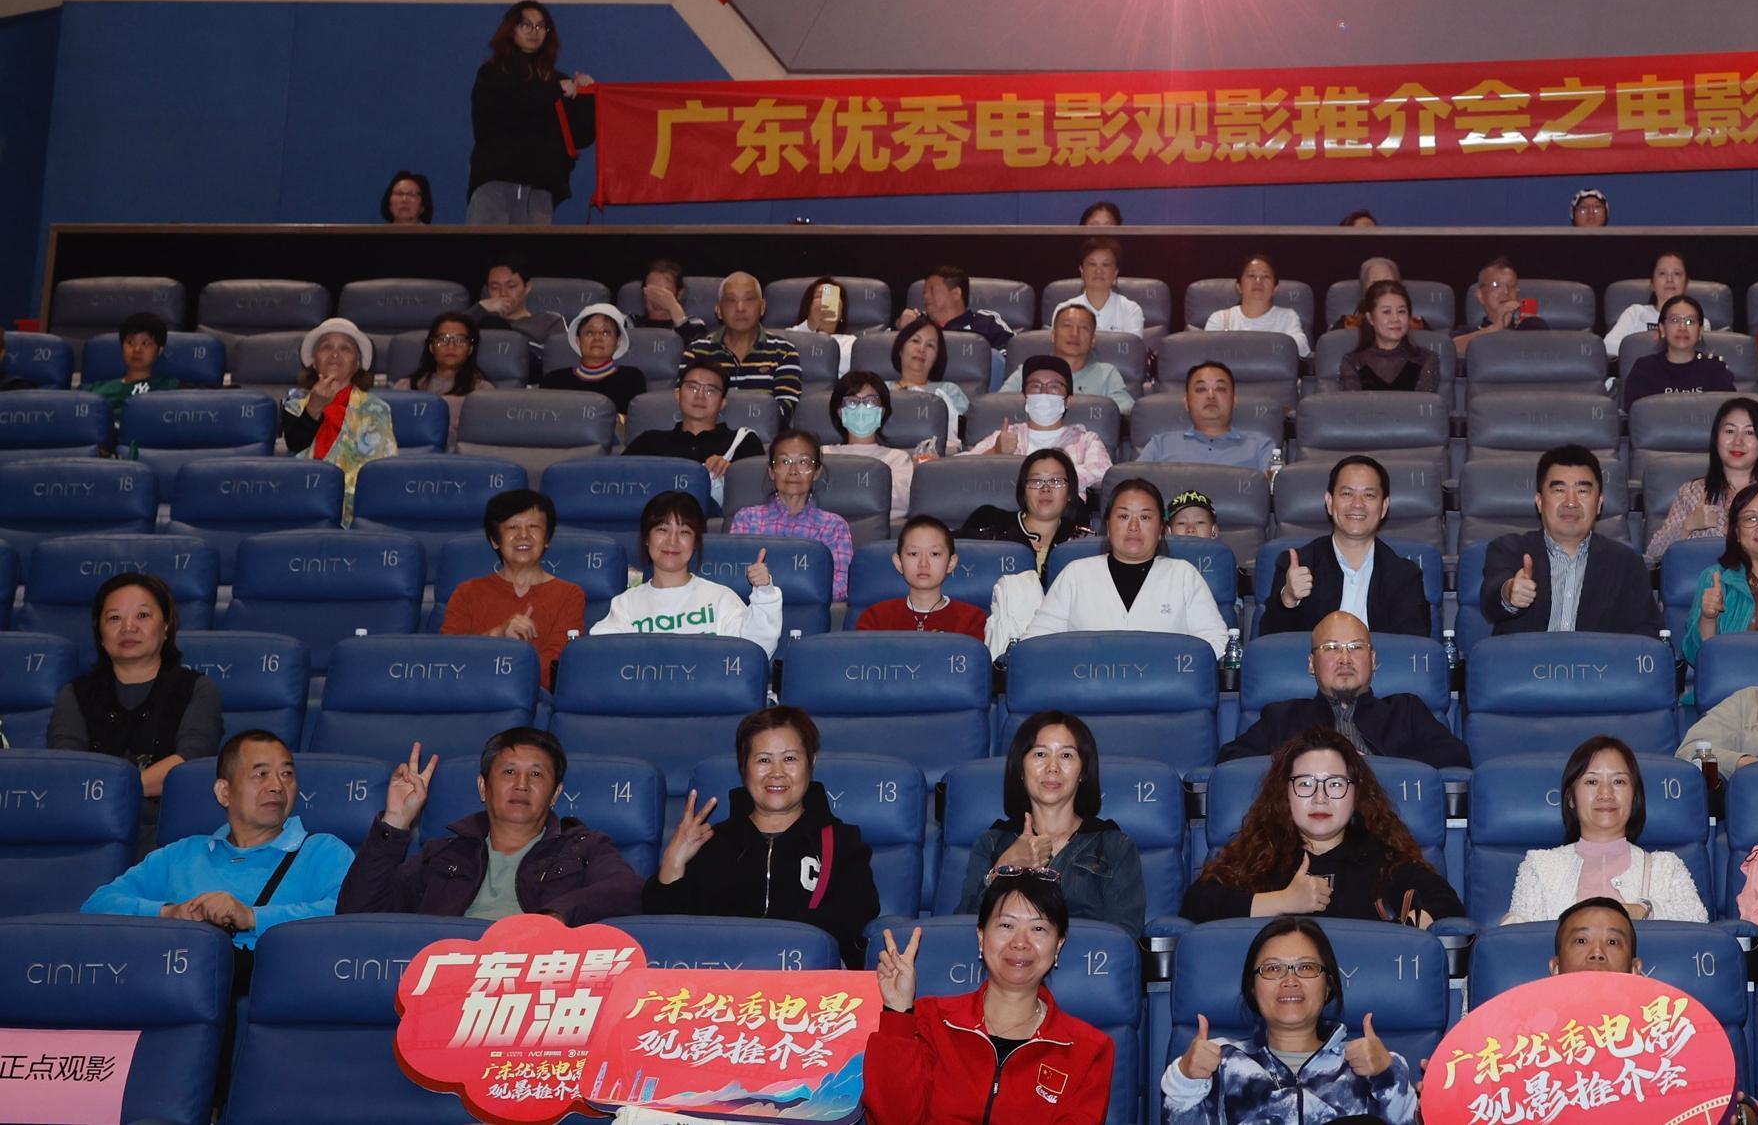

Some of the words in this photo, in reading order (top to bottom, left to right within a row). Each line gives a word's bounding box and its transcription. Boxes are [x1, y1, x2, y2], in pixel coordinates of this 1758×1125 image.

[236, 294, 281, 308] CINITY
[377, 295, 423, 308] CINITY
[440, 292, 453, 305] 18
[865, 289, 876, 301] 15
[1009, 290, 1020, 302] 14
[1146, 289, 1157, 300] 13
[1289, 290, 1300, 301] 12
[32, 347, 52, 361] 20
[193, 347, 206, 360] 19
[497, 341, 511, 354] 17
[653, 340, 666, 354] 16
[811, 344, 823, 356] 15
[962, 344, 973, 356] 14
[1117, 343, 1129, 355] 13
[1272, 343, 1284, 355] 12
[1430, 343, 1441, 355] 11
[1580, 344, 1592, 356] 10
[1736, 344, 1743, 356] 9
[74, 405, 88, 418] 19
[163, 410, 219, 424] CINITY
[240, 405, 255, 418] 18
[413, 403, 427, 417] 17
[506, 408, 561, 422] CINITY
[582, 405, 597, 419] 16
[748, 405, 761, 419] 15
[916, 405, 929, 419] 14
[1089, 406, 1102, 419] 13
[1255, 405, 1269, 418] 12
[1418, 404, 1433, 418] 11
[1591, 406, 1604, 420] 10
[119, 477, 134, 492] 18
[220, 480, 280, 494] CINITY
[306, 475, 320, 490] 17
[405, 480, 466, 494] CINITY
[488, 473, 503, 488] 16
[673, 475, 688, 490] 15
[856, 472, 870, 487] 14
[1237, 480, 1251, 494] 12
[1410, 472, 1425, 487] 11
[33, 481, 95, 496] CINITY
[590, 481, 651, 495] CINITY
[174, 554, 191, 570] 17
[289, 557, 357, 573] CINITY
[381, 549, 399, 566] 16
[586, 553, 602, 569] 15
[791, 554, 808, 570] 14
[999, 556, 1015, 573] 13
[1198, 555, 1214, 572] 12
[80, 560, 148, 575] CINITY
[631, 602, 716, 634] mardi
[25, 653, 45, 671] 17
[260, 654, 279, 672] 16
[494, 656, 512, 674] 15
[722, 656, 742, 675] 14
[948, 655, 967, 673] 13
[1174, 654, 1194, 673] 12
[1410, 654, 1430, 673] 11
[1635, 654, 1655, 673] 10
[389, 662, 467, 680] CINITY
[621, 664, 697, 681] CINITY
[845, 663, 921, 681] CINITY
[1074, 662, 1149, 680] CINITY
[1533, 664, 1609, 680] CINITY
[81, 780, 103, 801] 16
[346, 780, 367, 801] 15
[611, 781, 632, 802] 14
[876, 781, 897, 803] 13
[1134, 781, 1156, 803] 12
[1400, 780, 1422, 801] 11
[1661, 778, 1682, 800] 10
[163, 949, 189, 975] 15
[777, 950, 803, 971] 13
[1082, 950, 1110, 975] 12
[1394, 954, 1420, 980] 11
[1691, 952, 1716, 977] 10
[27, 962, 128, 985] CINITY
[411, 947, 637, 996] 广东电影
[448, 989, 604, 1049] 加油
[625, 987, 865, 1042] 广东优秀电影
[632, 1025, 836, 1072] 观影推介会
[1442, 995, 1698, 1091] 广东优秀电影
[0, 1054, 116, 1082] 正点观影
[1466, 1058, 1689, 1125] 观影推介会
